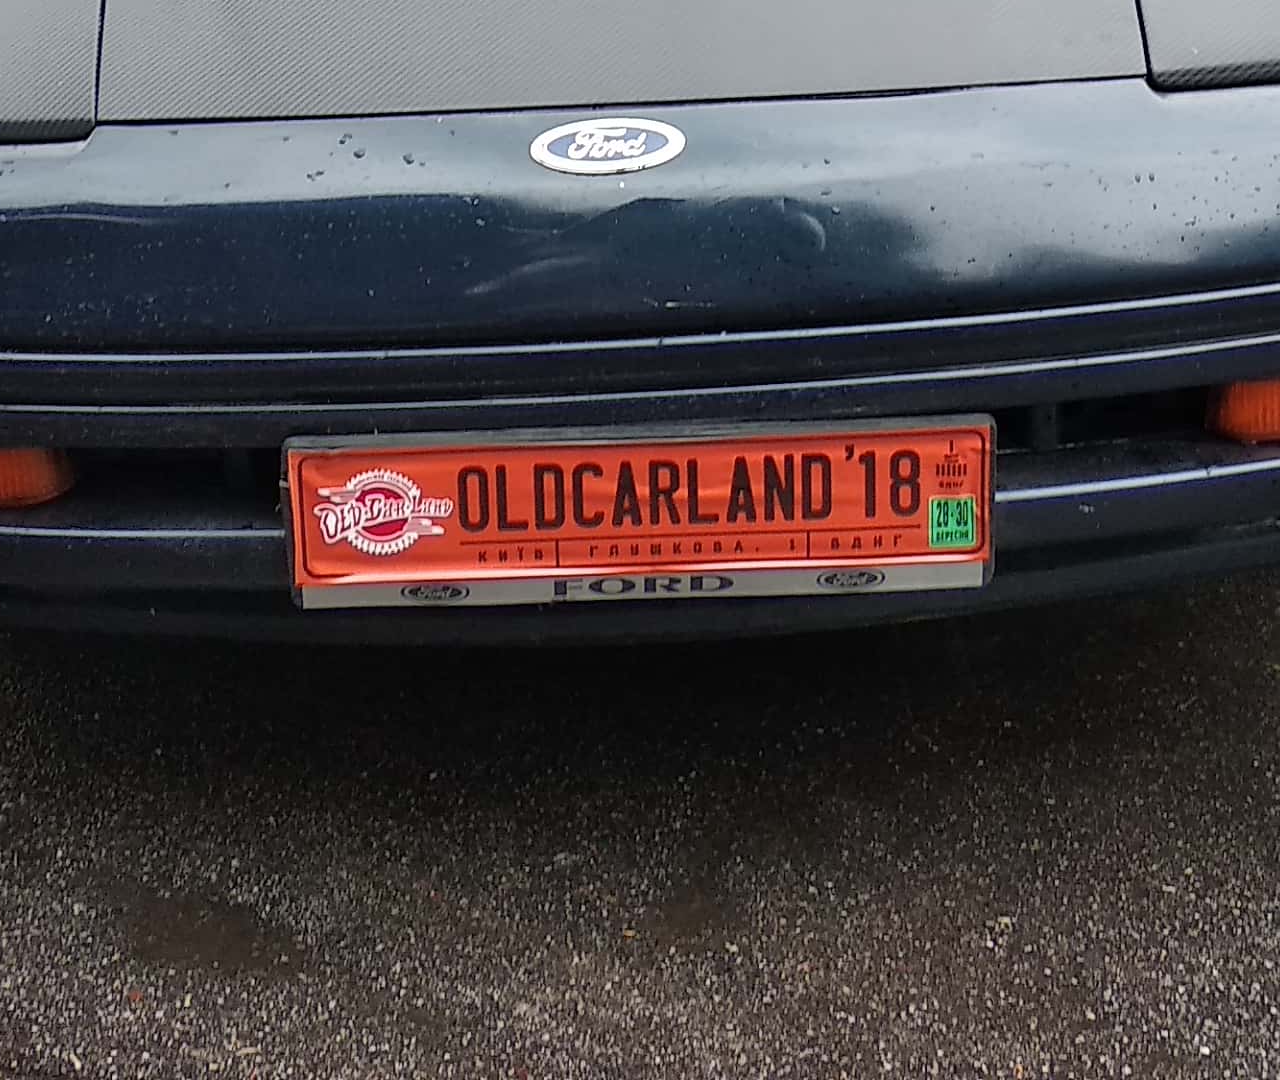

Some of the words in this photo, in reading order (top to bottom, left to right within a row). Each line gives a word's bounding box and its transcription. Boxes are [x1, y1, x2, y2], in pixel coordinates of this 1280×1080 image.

[568, 128, 648, 159] Ford
[478, 546, 544, 563] КИЇВ
[831, 534, 902, 549] ВДНГ
[553, 575, 734, 597] FORD
